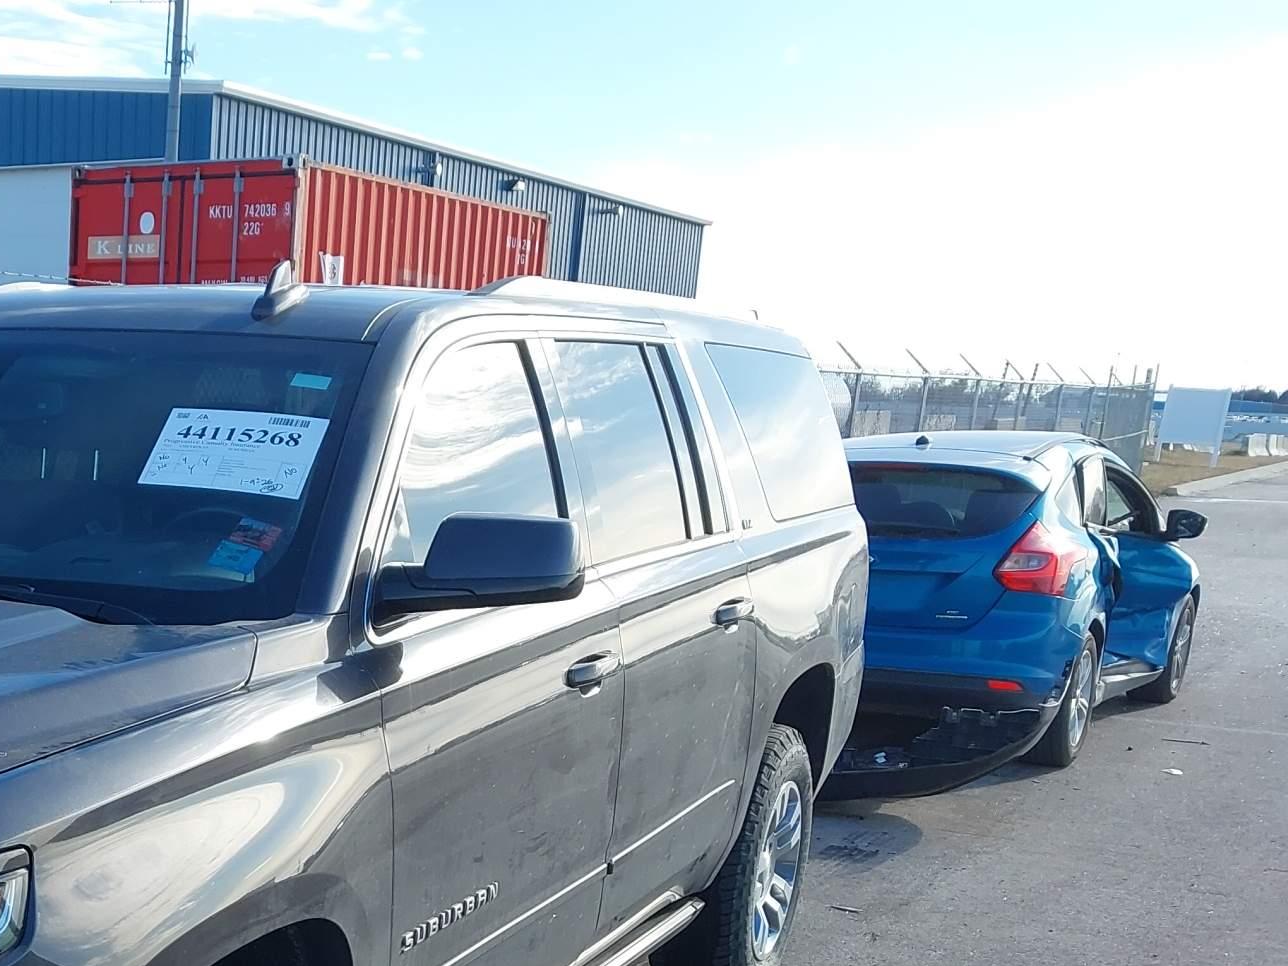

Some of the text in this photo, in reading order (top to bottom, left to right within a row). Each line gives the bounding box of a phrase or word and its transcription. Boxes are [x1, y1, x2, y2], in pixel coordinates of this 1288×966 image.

[208, 204, 233, 219] KKTU
[243, 203, 277, 217] 742036
[96, 240, 156, 255] K LINE
[176, 424, 303, 448] 44115268
[400, 881, 499, 952] SUBURBAN
